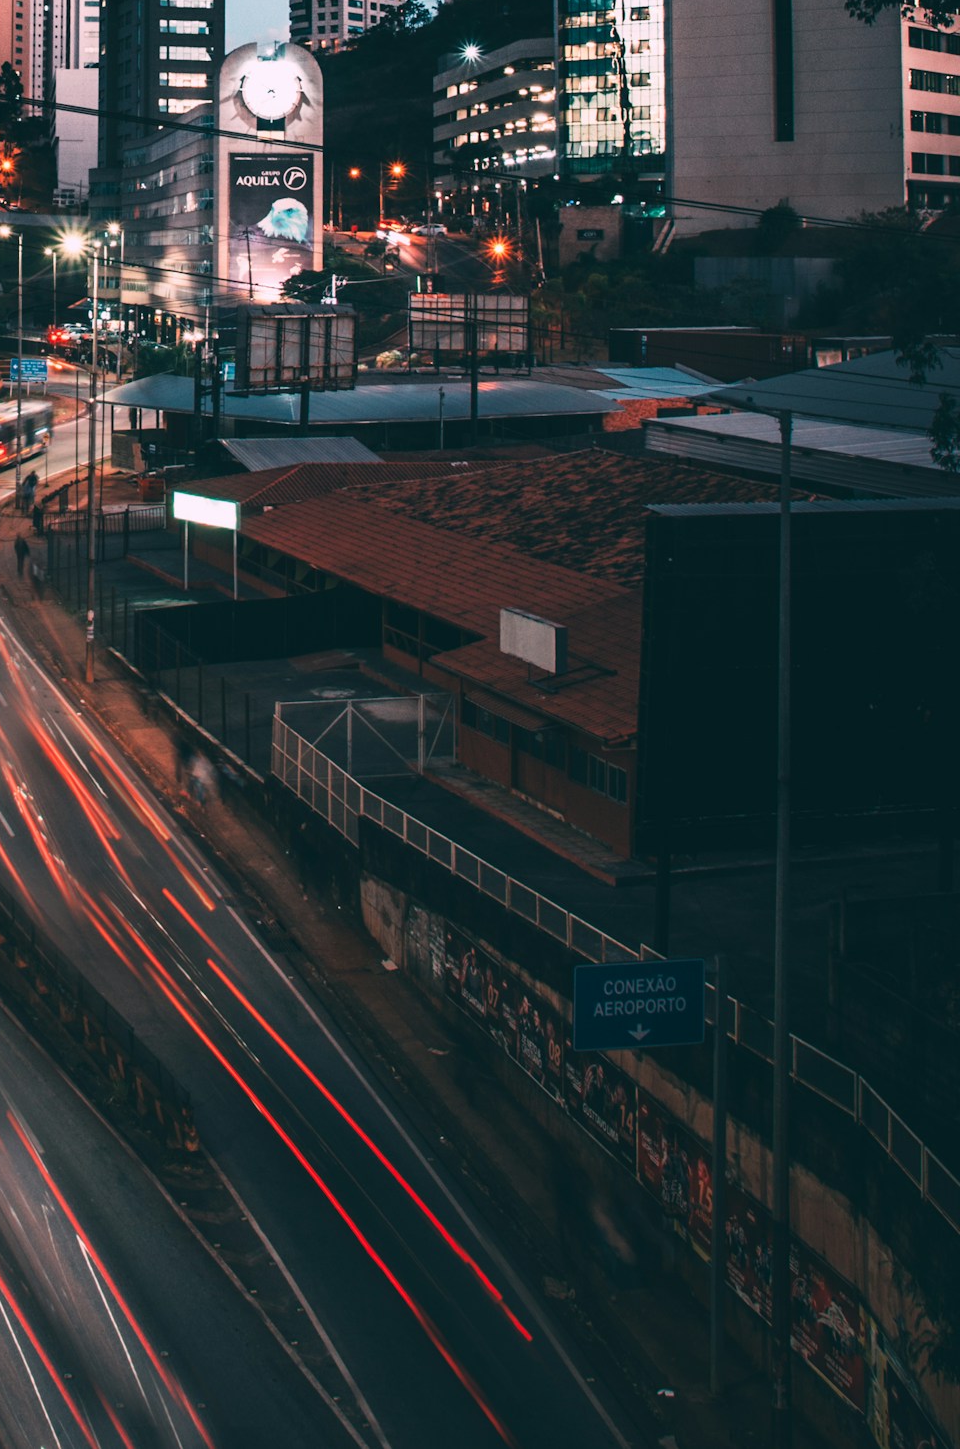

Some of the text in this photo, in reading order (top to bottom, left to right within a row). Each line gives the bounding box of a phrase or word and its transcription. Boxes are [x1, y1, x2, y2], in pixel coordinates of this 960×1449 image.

[236, 176, 280, 187] AQUILA
[487, 983, 499, 1008] 07
[603, 974, 676, 996] CONEXÃO
[593, 997, 686, 1017] AEROPORTO
[549, 1038, 561, 1066] 08
[620, 1104, 633, 1134] 14
[698, 1180, 713, 1213] 15
